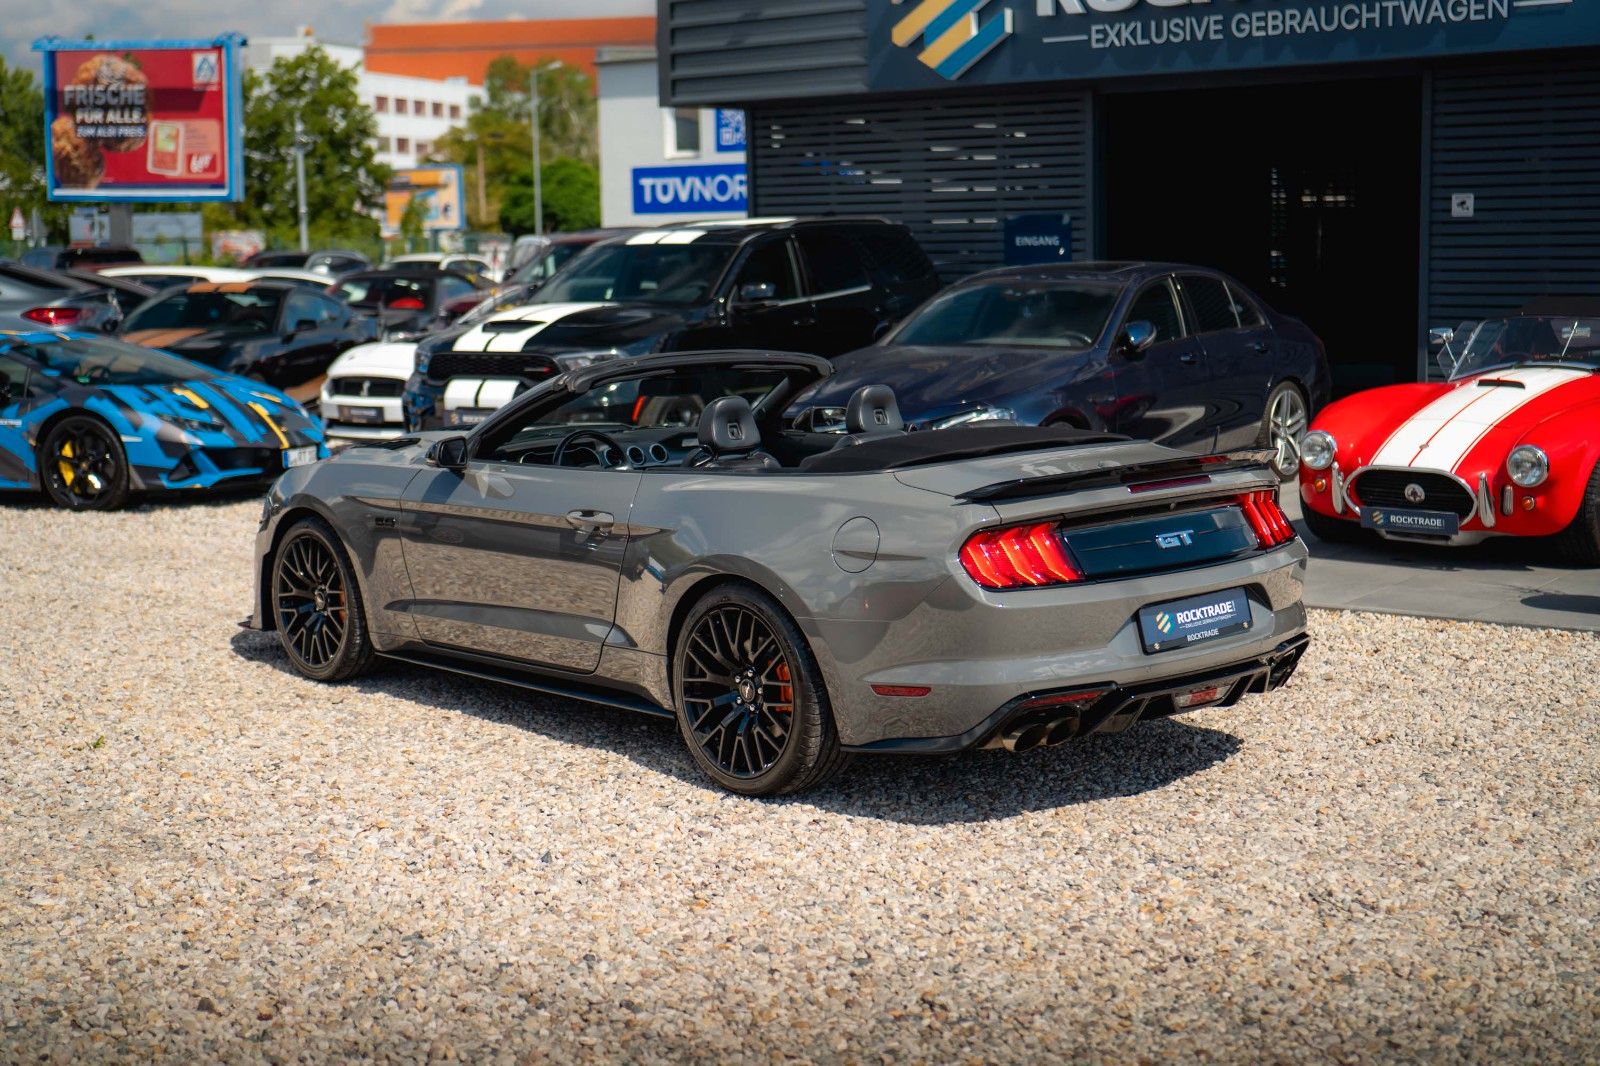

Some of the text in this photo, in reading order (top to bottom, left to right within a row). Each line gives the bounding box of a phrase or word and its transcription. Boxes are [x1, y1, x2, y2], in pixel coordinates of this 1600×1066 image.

[1090, 14, 1224, 49] EXKLUSIVE
[1231, 0, 1509, 39] GEBRAUCHTWAGEN
[63, 83, 145, 106] FRISCHE
[1015, 235, 1060, 247] EINGANG
[1389, 514, 1442, 527] ROCKTRADE
[1155, 530, 1194, 549] GT
[1176, 601, 1233, 624] ROCKTRADE
[1186, 628, 1220, 642] ROCKTRADE
